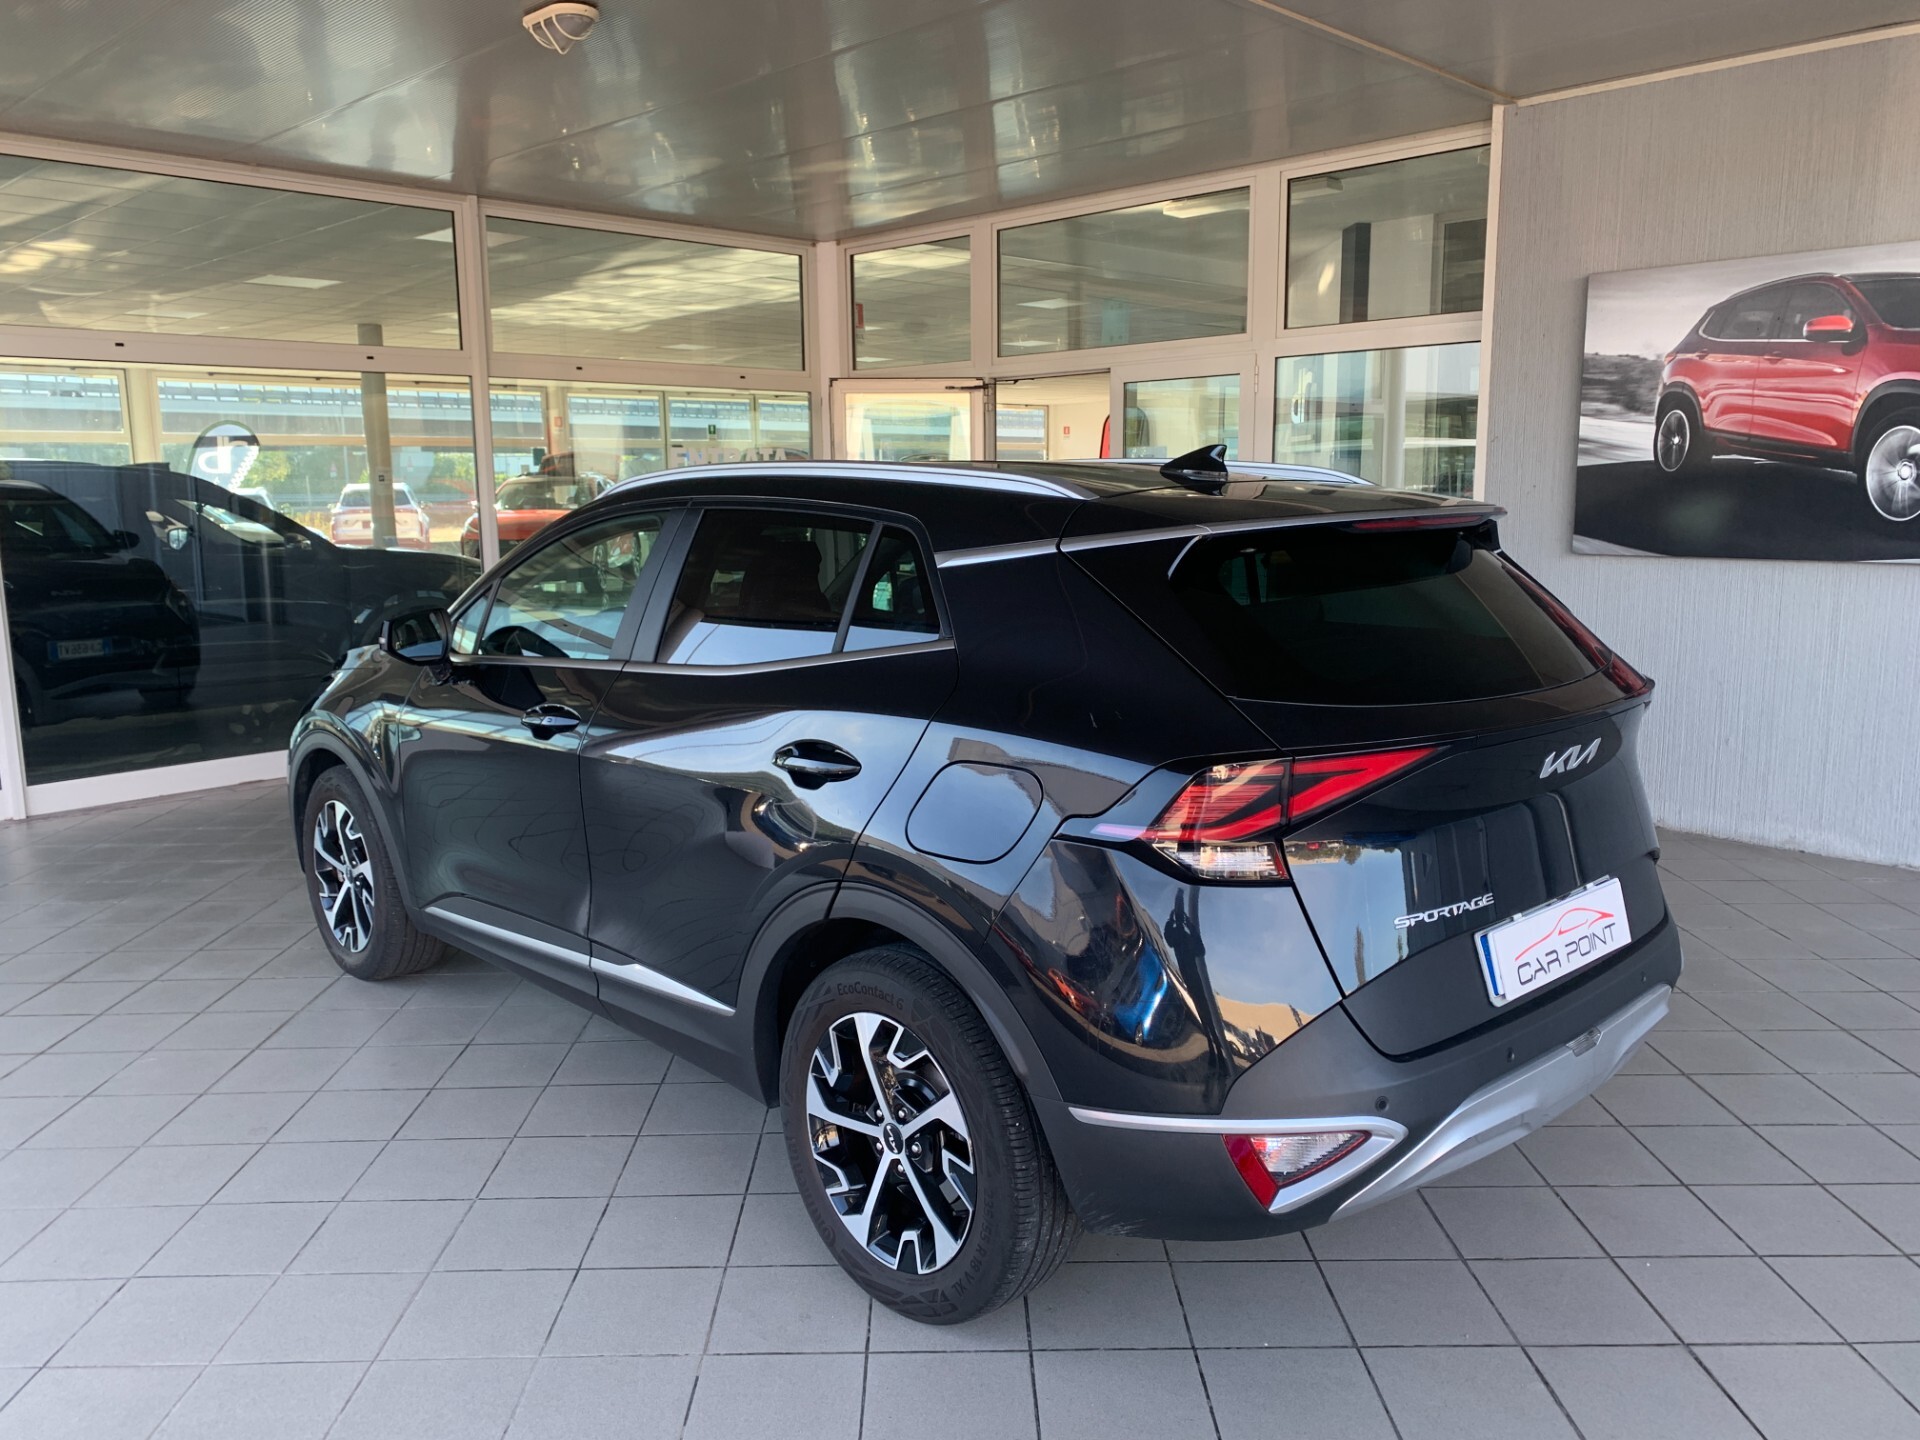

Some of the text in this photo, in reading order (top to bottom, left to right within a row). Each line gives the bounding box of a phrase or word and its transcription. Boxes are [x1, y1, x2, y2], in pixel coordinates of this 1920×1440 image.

[1539, 736, 1602, 779] KIA
[1394, 892, 1495, 929] SPORTAGE
[1517, 922, 1616, 986] CAR POINT
[836, 981, 905, 1011] EcoContact 6
[969, 1255, 983, 1273] 18
